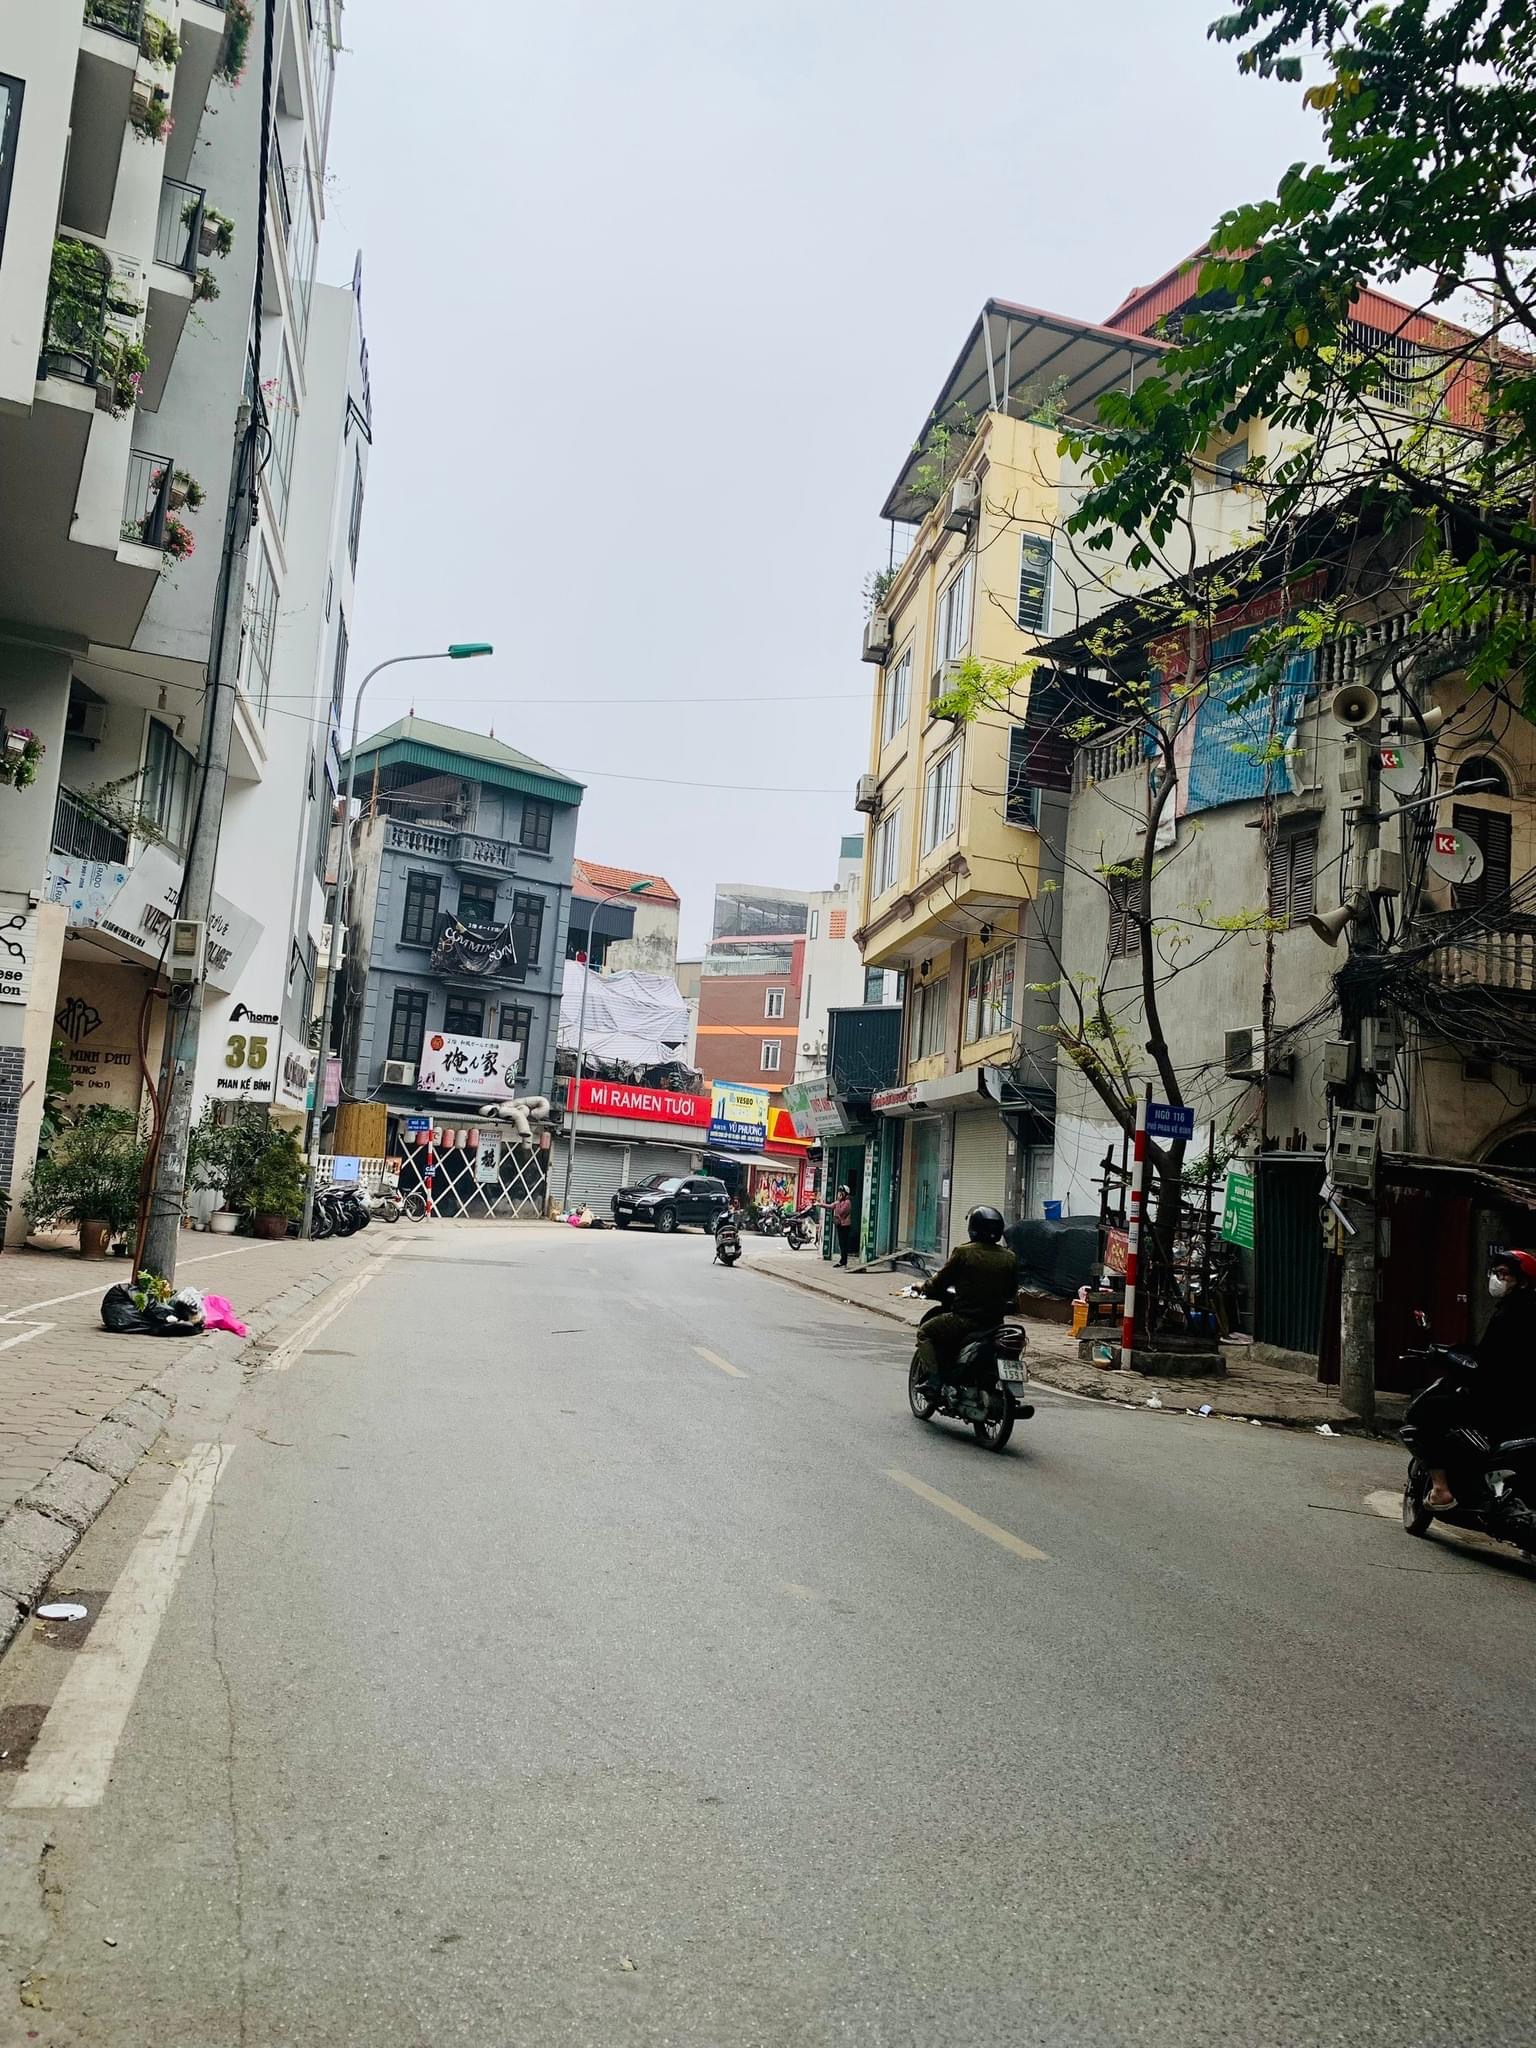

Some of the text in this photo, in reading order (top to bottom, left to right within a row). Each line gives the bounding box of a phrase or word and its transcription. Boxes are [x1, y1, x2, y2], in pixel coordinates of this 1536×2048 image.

[69, 1049, 100, 1063] MINH
[225, 1034, 268, 1070] 35
[217, 1078, 238, 1089] PHAN
[590, 1085, 695, 1117] MÌ RAMEN TƯƠI
[1154, 1109, 1185, 1122] NGÕ 116
